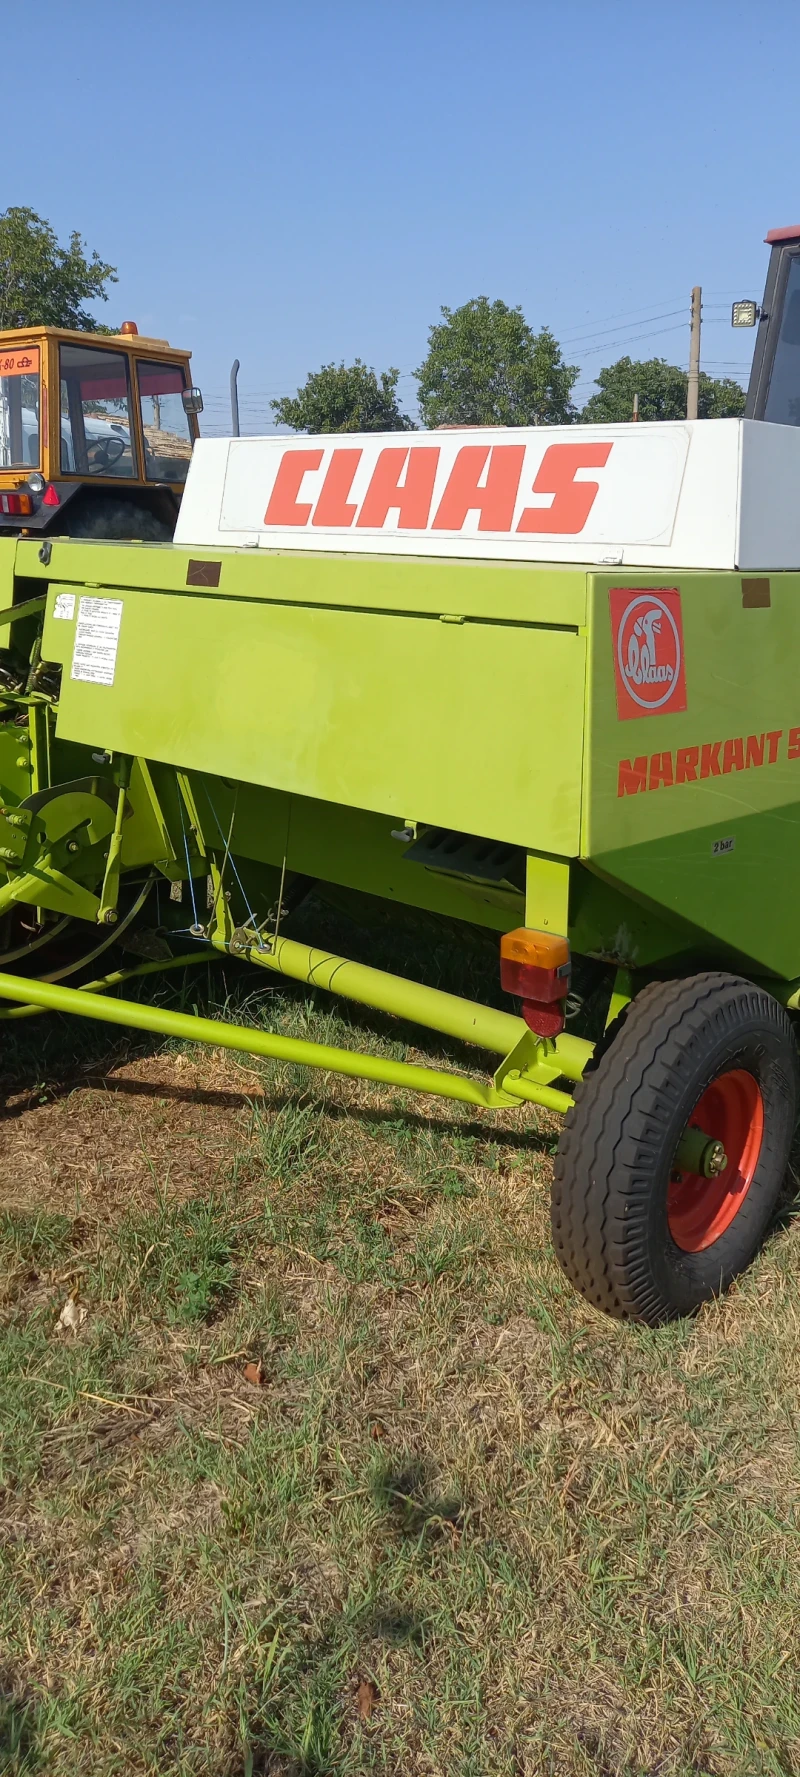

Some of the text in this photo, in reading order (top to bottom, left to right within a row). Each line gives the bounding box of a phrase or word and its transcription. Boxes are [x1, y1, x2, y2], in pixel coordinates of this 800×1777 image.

[0, 358, 14, 370] -80
[264, 442, 614, 534] CLAAS
[617, 730, 783, 798] MARKANT
[713, 840, 733, 853] 2 bar
